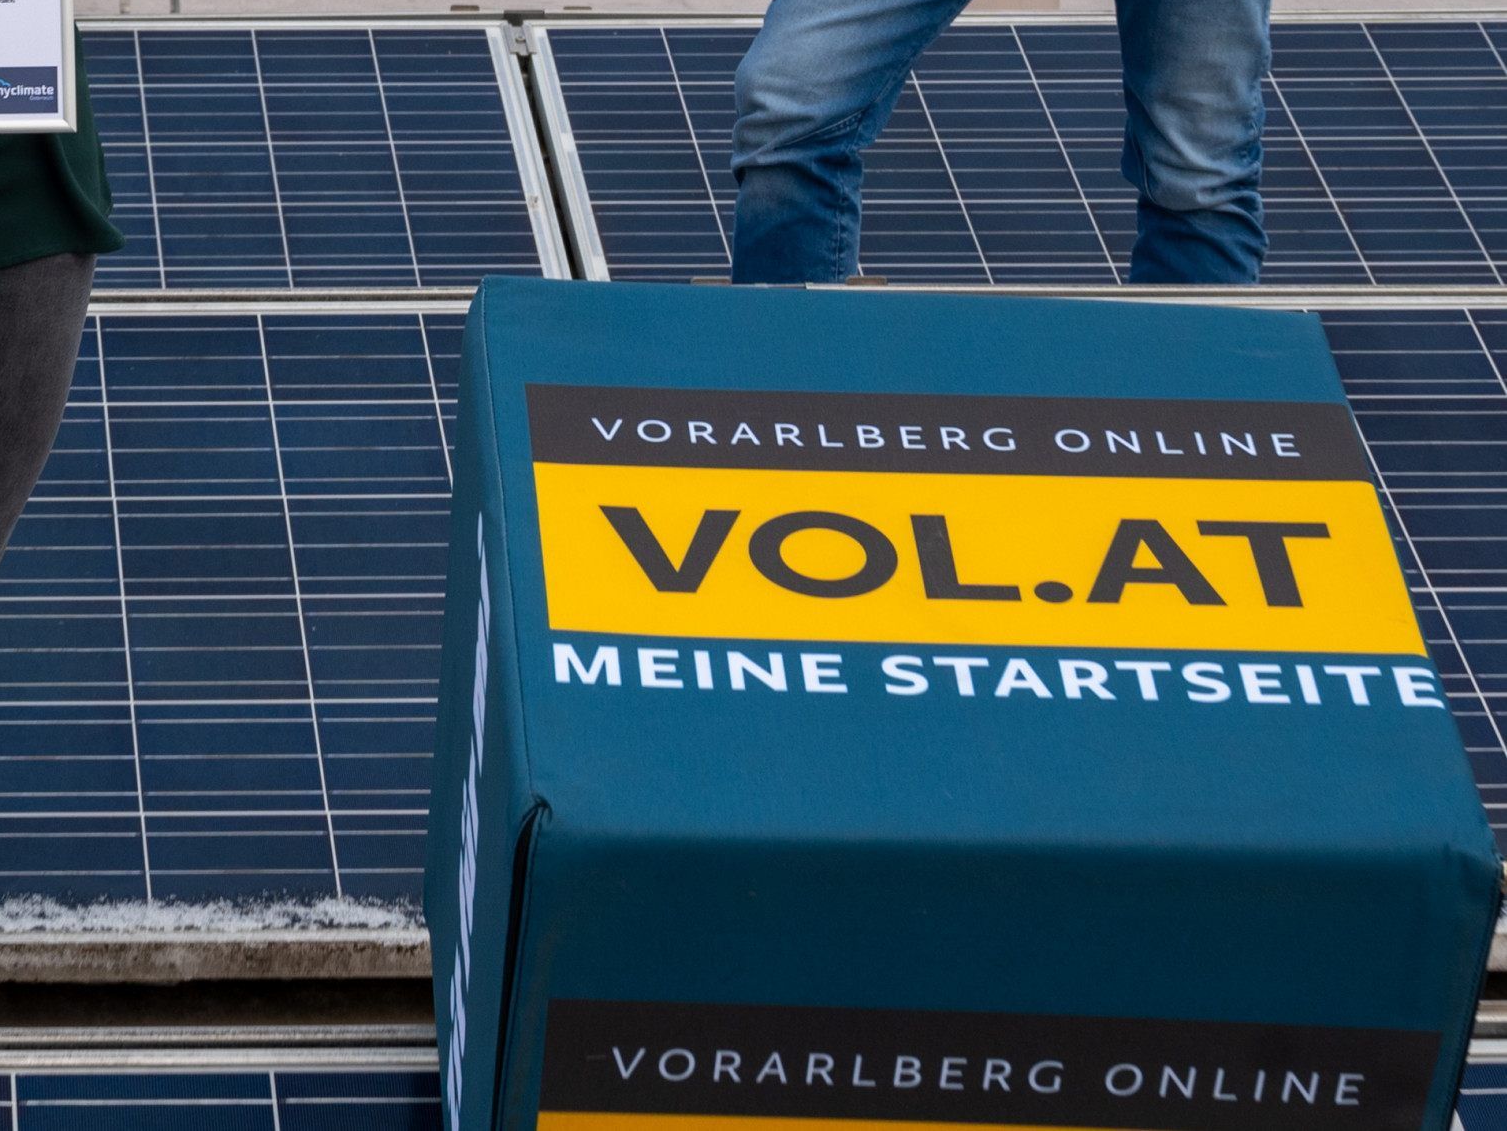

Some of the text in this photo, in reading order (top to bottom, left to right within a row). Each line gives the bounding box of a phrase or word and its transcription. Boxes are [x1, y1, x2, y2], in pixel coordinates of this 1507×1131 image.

[591, 416, 1303, 458] VORARLBERG ONLINE
[598, 504, 1331, 609] VOL.AT
[552, 642, 1447, 710] MEINE STARTSEITE
[612, 1046, 1366, 1105] VORARLBERG ONLINE
